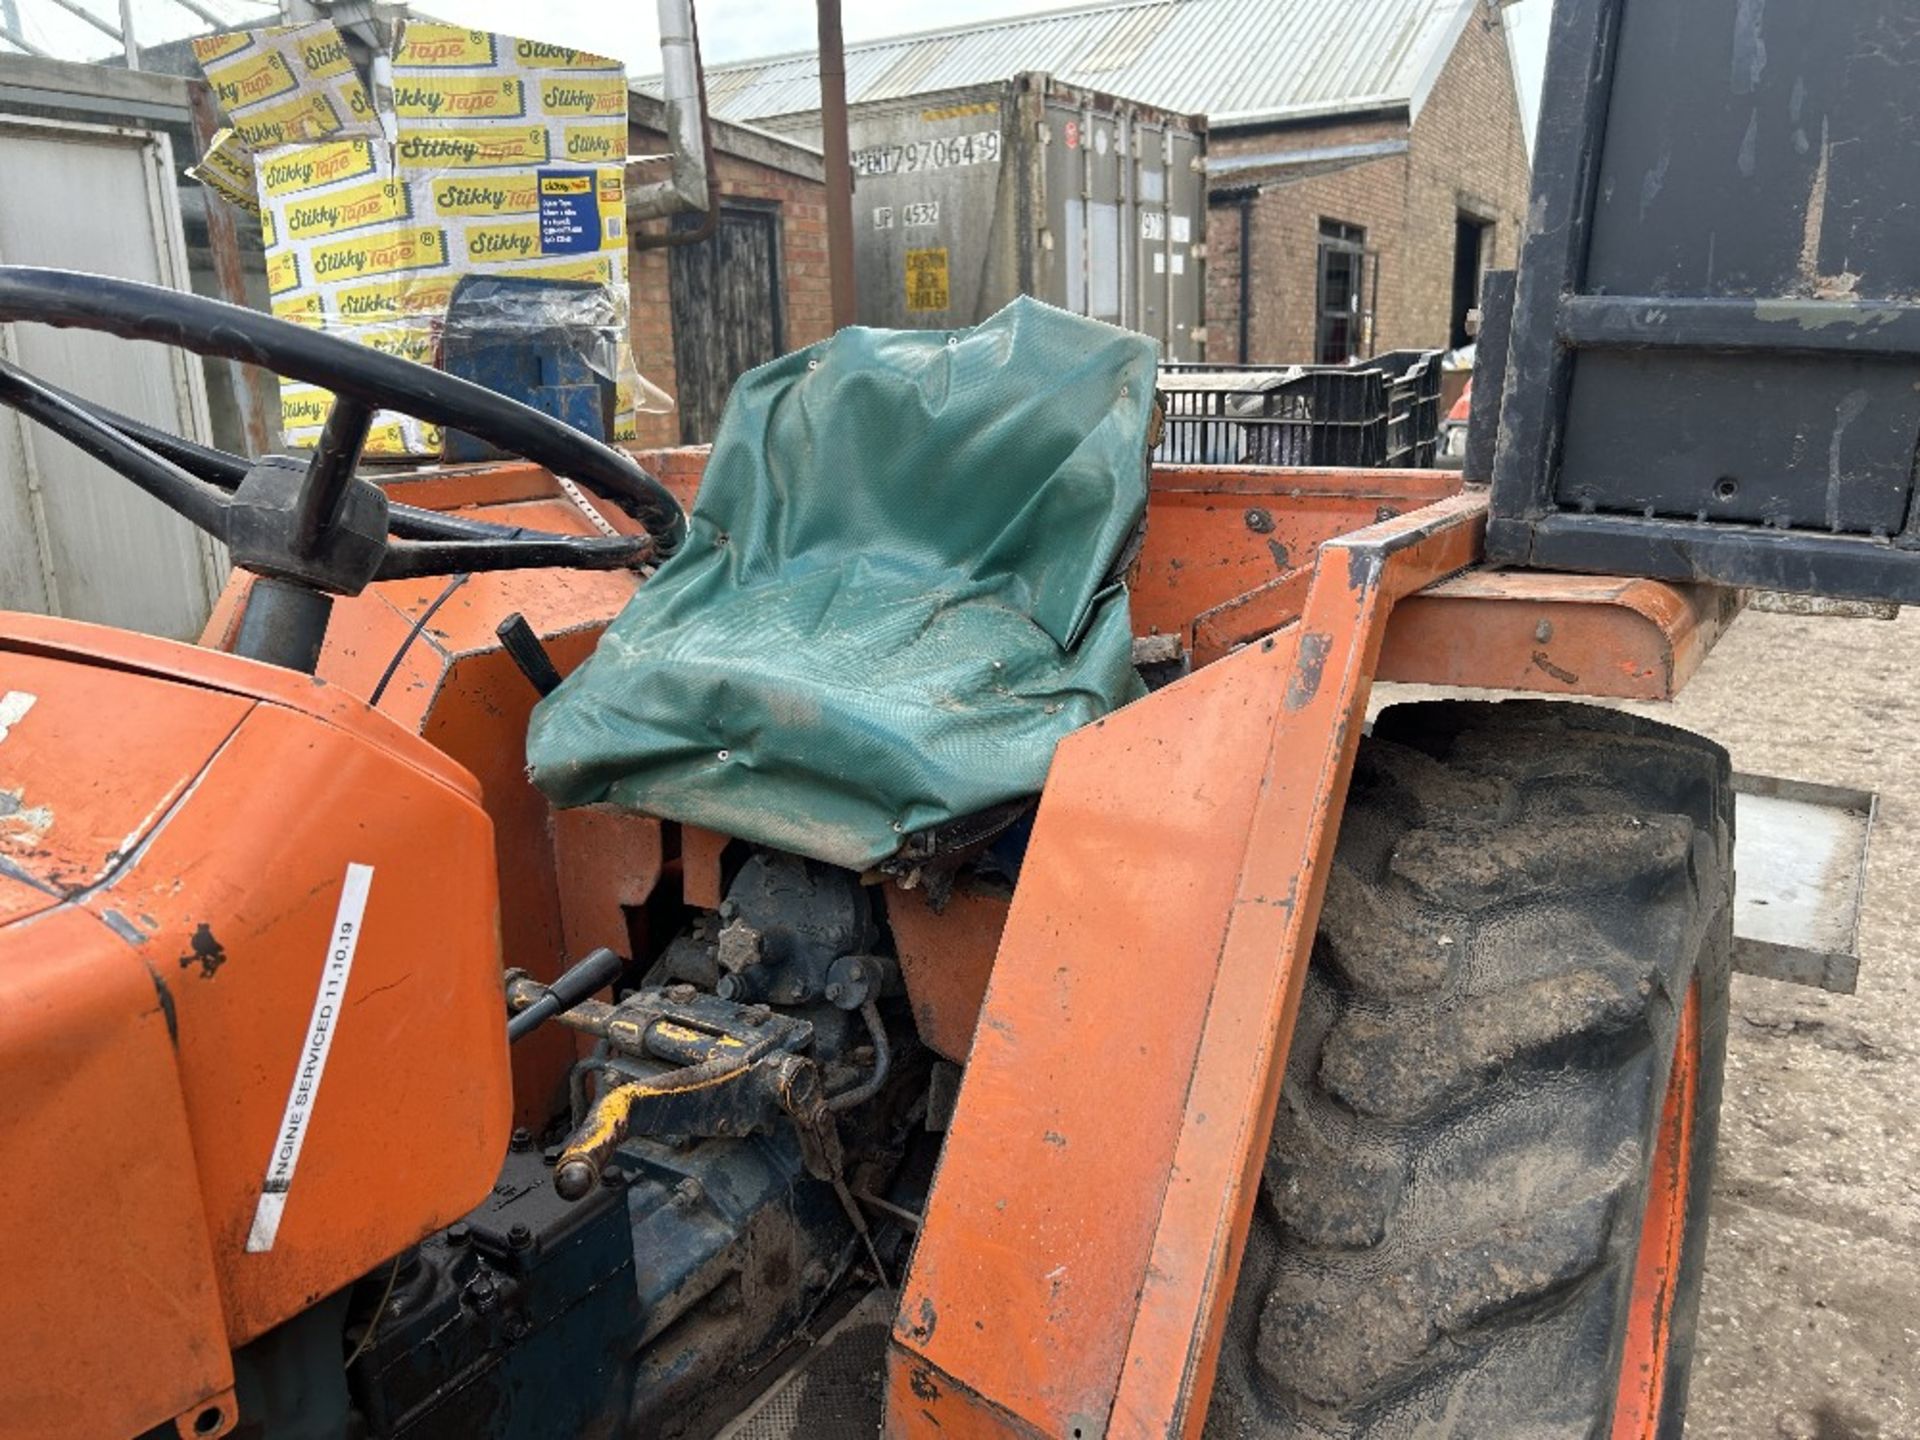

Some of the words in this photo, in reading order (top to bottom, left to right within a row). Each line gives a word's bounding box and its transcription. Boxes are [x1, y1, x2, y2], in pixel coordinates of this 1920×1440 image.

[409, 37, 465, 60] Tape
[443, 89, 499, 113] Tape
[543, 85, 596, 111] Stikky
[400, 136, 481, 162] Stikky
[478, 138, 528, 161] Tape
[567, 133, 611, 156] Stikky
[266, 161, 314, 189] Stikky
[312, 149, 352, 180] Tape
[437, 185, 508, 211] Stikky
[289, 203, 341, 231] Stikky
[338, 193, 383, 223] Tape
[470, 231, 533, 255] Stikky
[315, 251, 368, 275] Stikky
[366, 240, 417, 269] Tape
[271, 1110, 303, 1192] ENGINE
[295, 1004, 334, 1107] SERVICED
